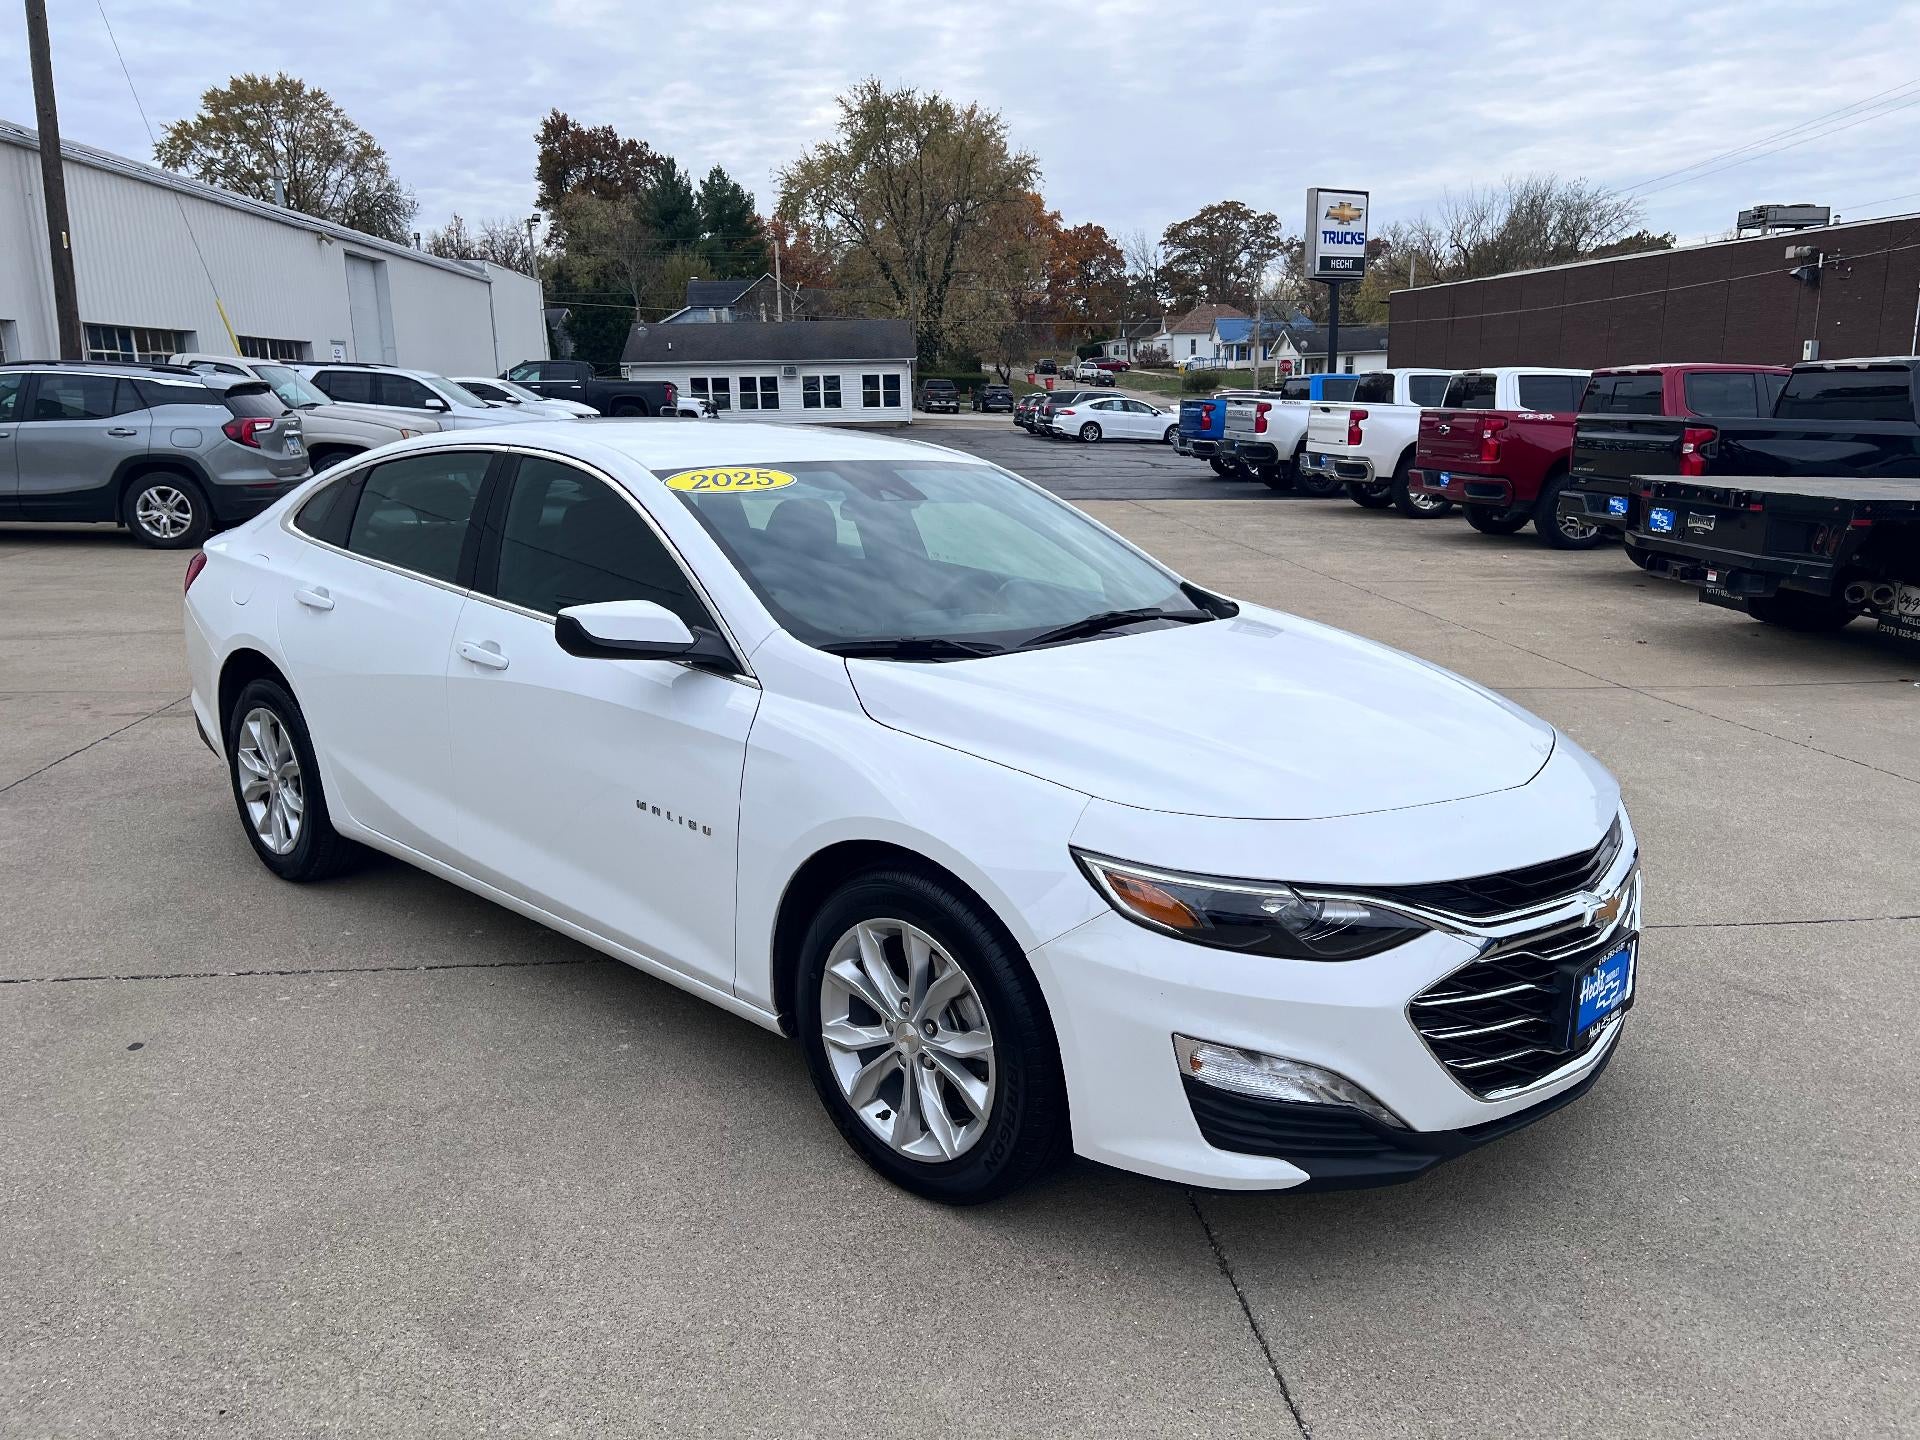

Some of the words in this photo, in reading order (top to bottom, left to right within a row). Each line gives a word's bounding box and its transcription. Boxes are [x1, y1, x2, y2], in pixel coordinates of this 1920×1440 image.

[1322, 231, 1364, 245] TRUCKS
[1330, 259, 1354, 269] HECHT
[690, 471, 775, 490] 2025
[636, 799, 712, 837] MALIBU
